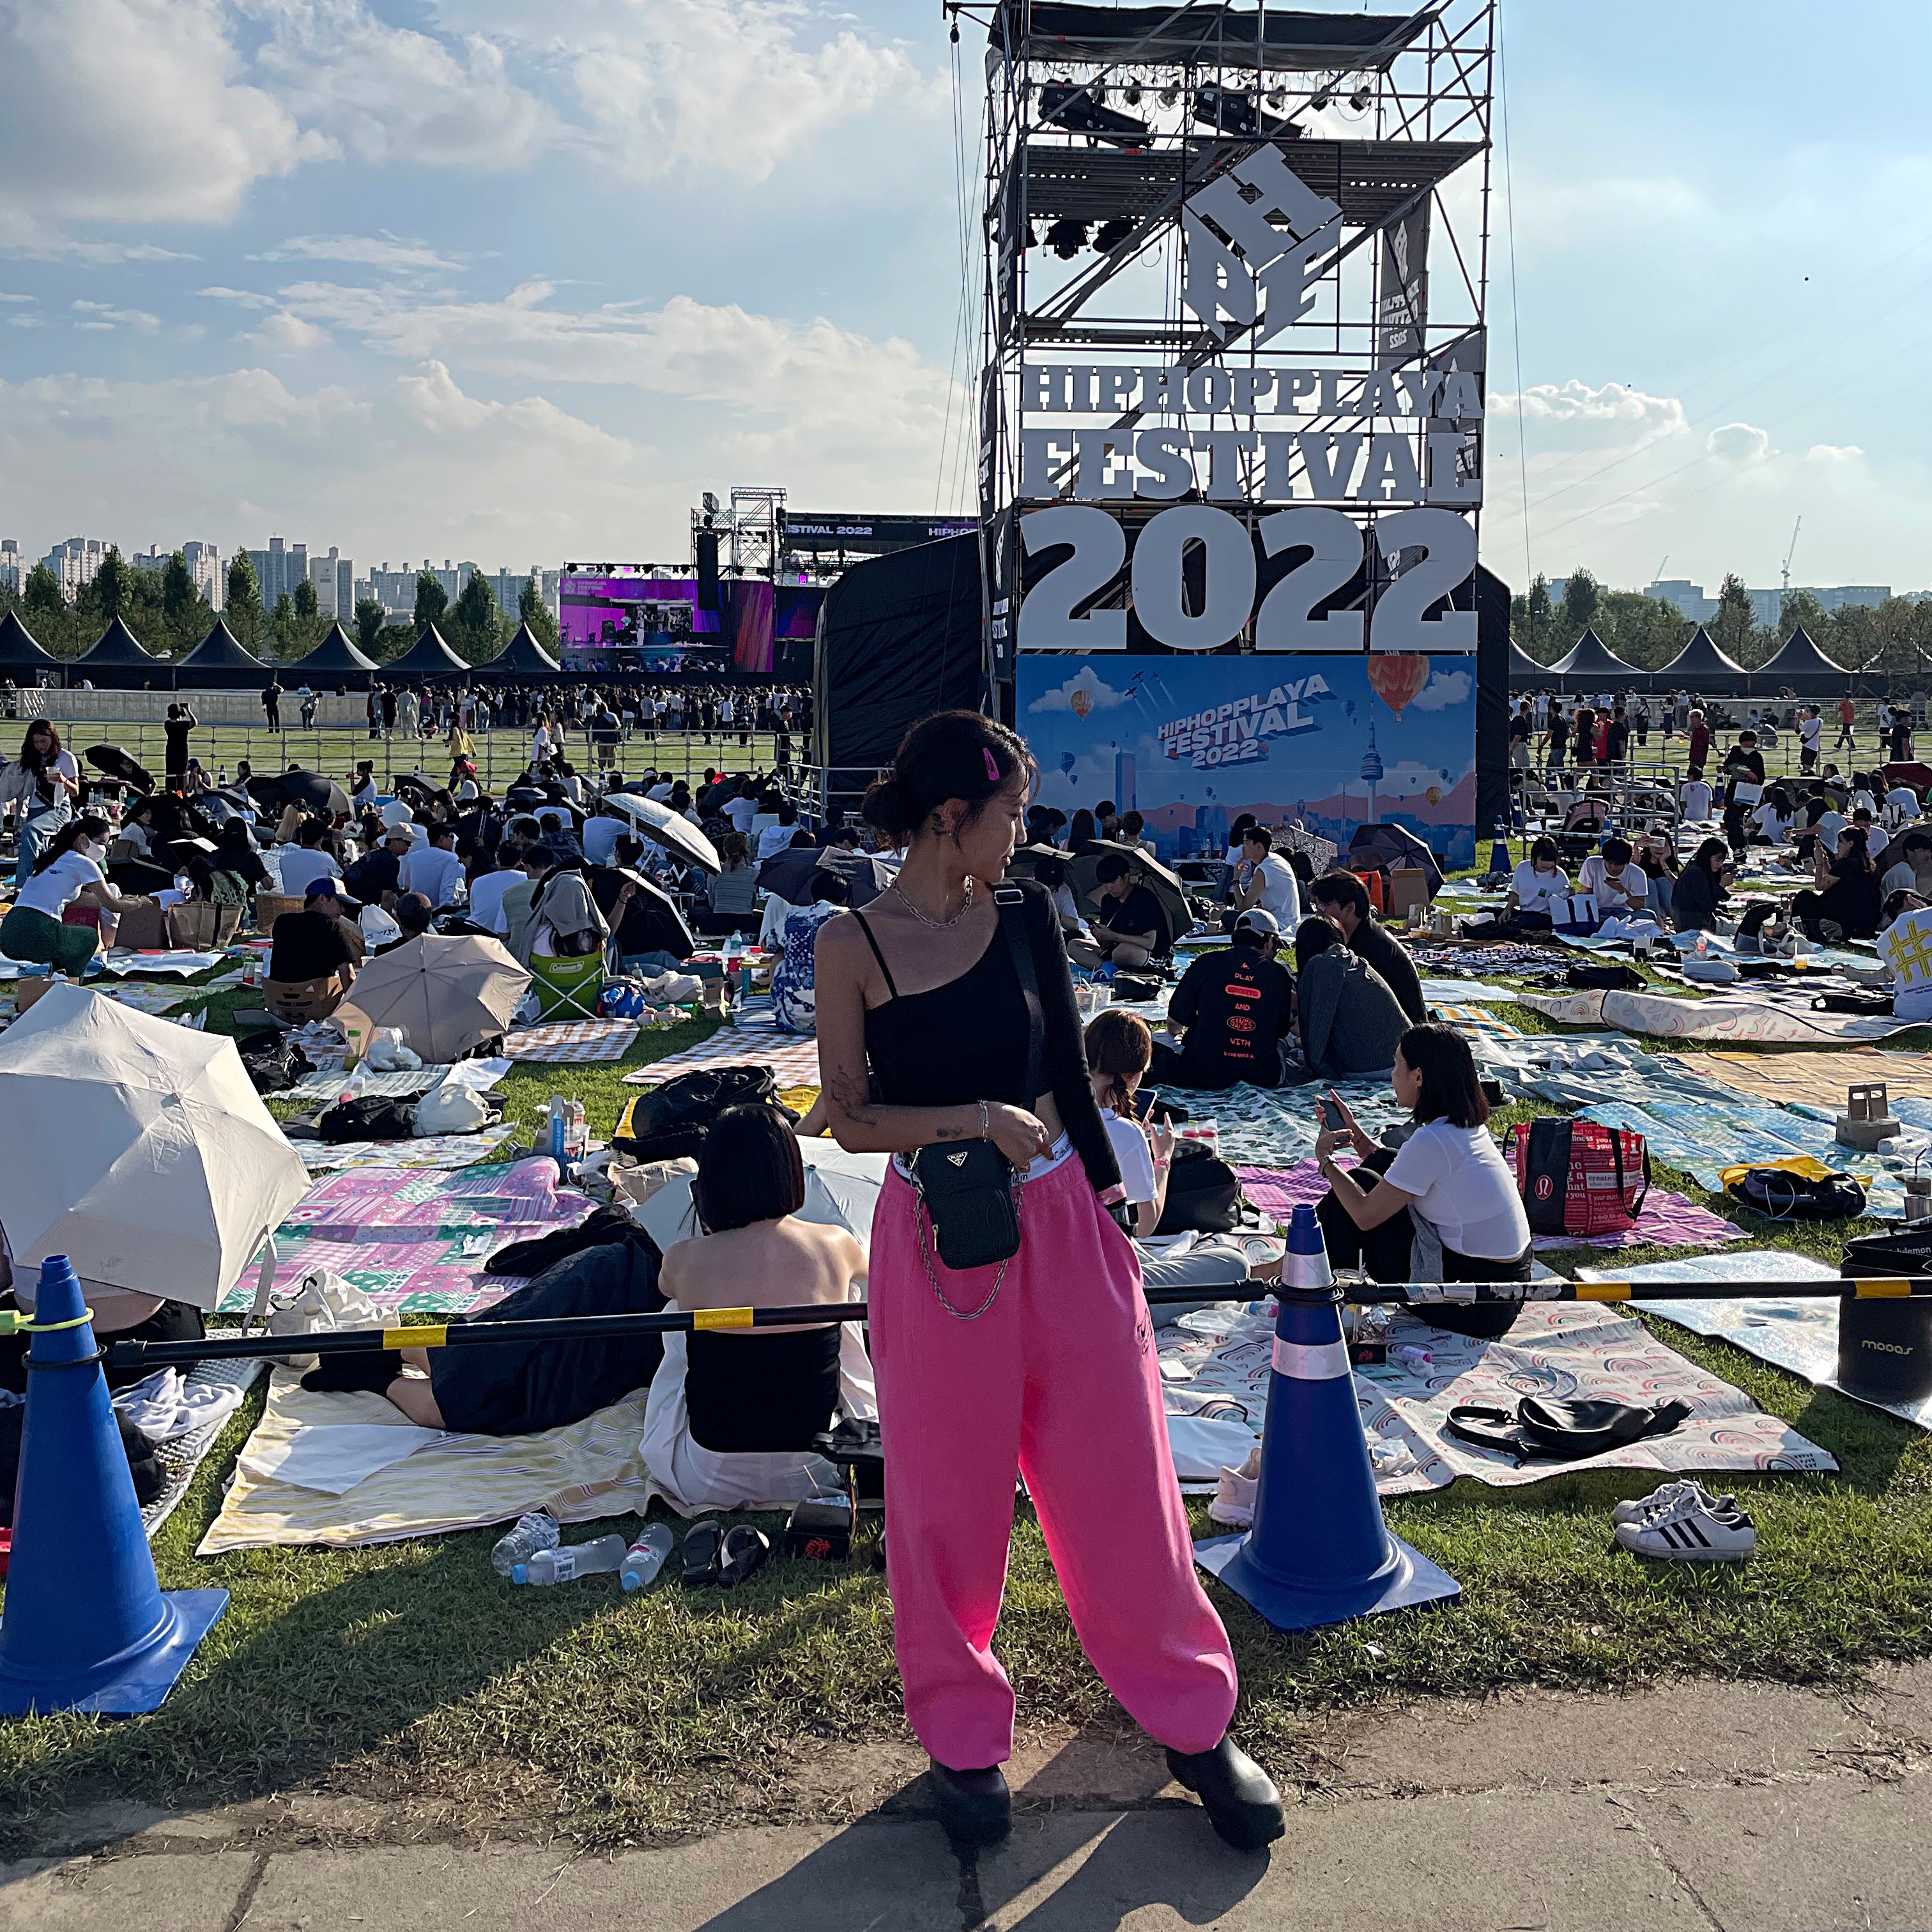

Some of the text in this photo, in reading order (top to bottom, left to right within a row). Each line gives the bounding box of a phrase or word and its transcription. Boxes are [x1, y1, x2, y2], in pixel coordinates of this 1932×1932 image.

[1021, 364, 1484, 419] HIPHOPPLAYA
[1019, 427, 1482, 502] FESTIVAL
[787, 525, 873, 535] ESTIVAL 2022
[1017, 505, 1479, 651] 2022
[1158, 674, 1330, 740] HIPHOPPLAYA
[1163, 702, 1314, 757] FESTIVAL
[1191, 739, 1259, 767] 2022
[1234, 972, 1254, 981] PLAY
[1234, 1002, 1250, 1011] AND
[1230, 1017, 1253, 1030] GAMES
[1230, 1037, 1251, 1047] WITH
[1567, 1182, 1585, 1191] hat
[1861, 1340, 1913, 1355] mooas
